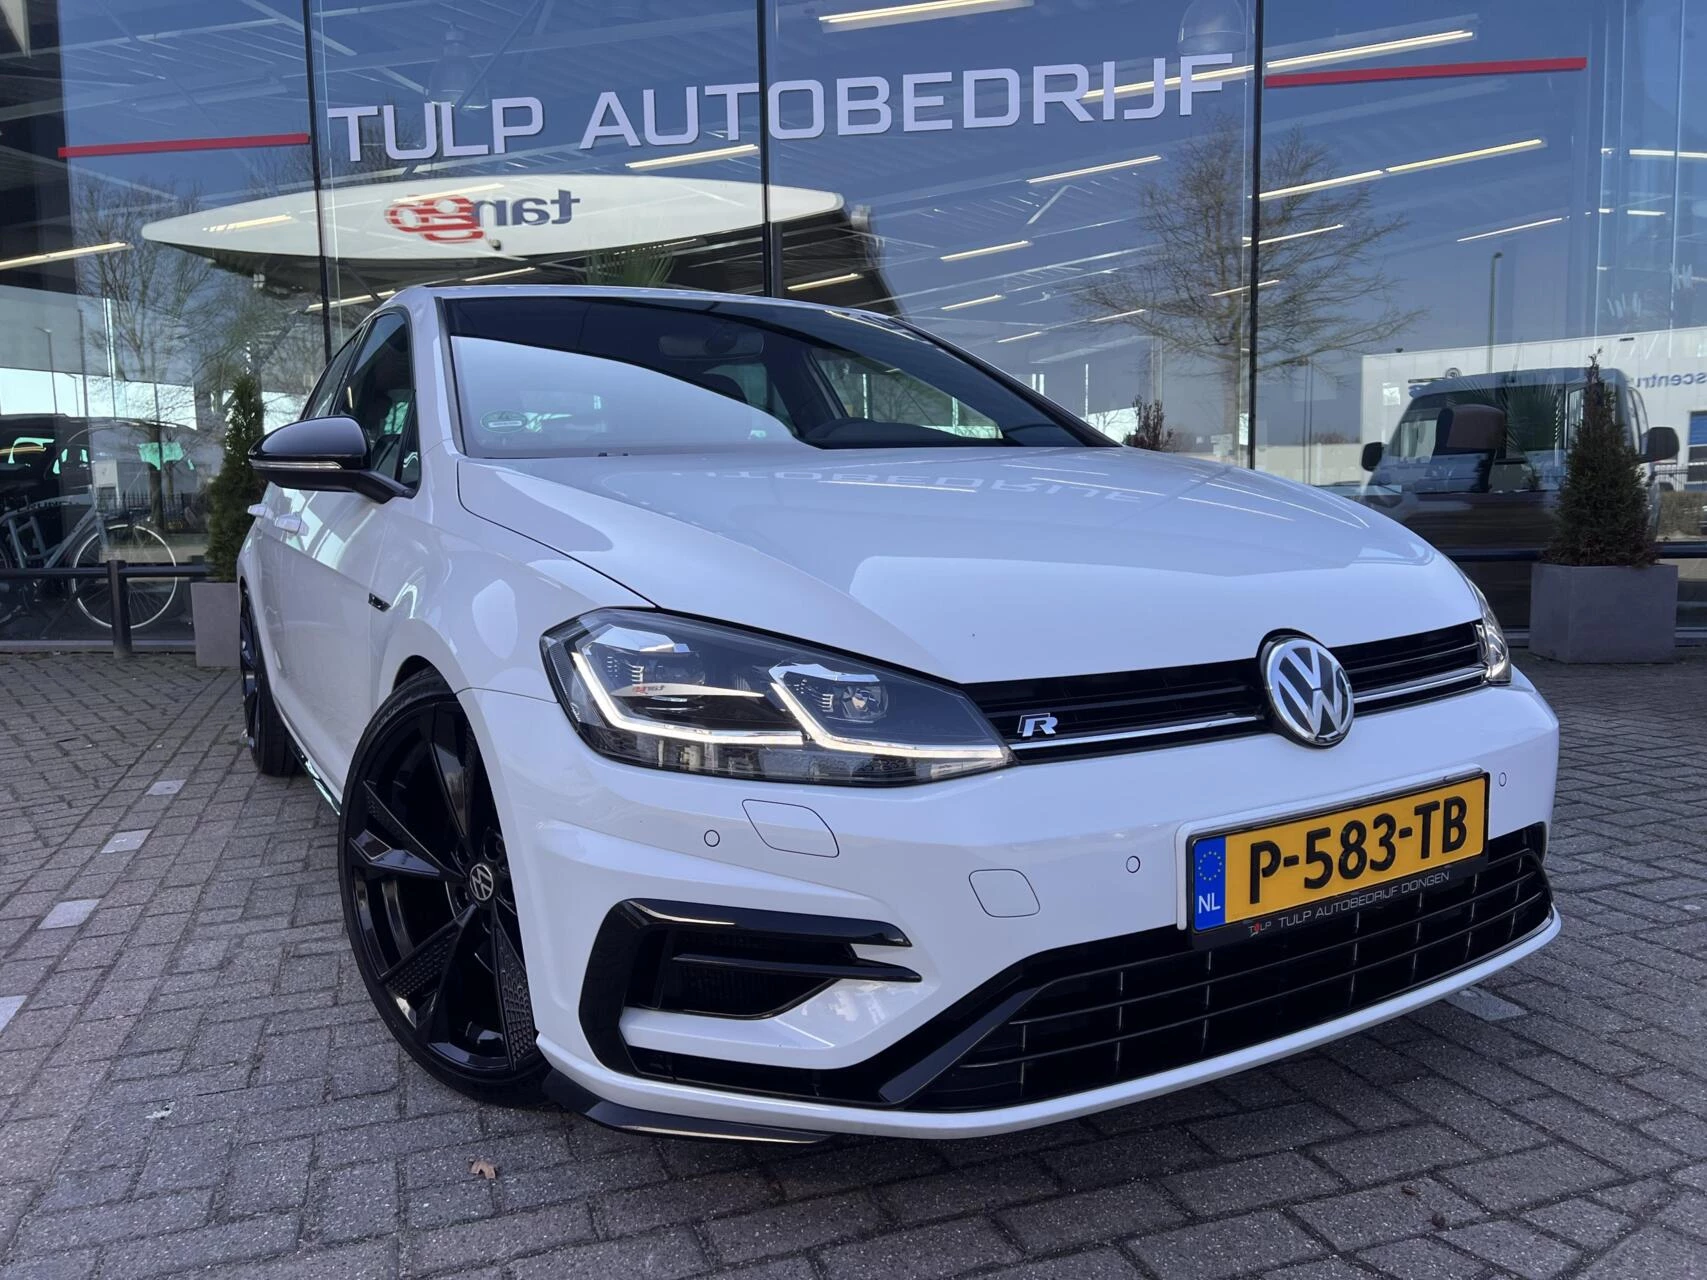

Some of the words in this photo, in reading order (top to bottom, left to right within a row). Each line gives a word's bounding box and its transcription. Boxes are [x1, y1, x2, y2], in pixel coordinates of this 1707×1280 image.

[328, 96, 544, 162] TULP
[579, 53, 1233, 149] AUTOBEDRIJF
[1021, 715, 1059, 738] R
[1249, 795, 1467, 905] P-583-TB
[1198, 892, 1221, 914] NL
[1279, 909, 1312, 930] TULP
[1315, 887, 1399, 920] AUTOBEDRIJF
[1401, 871, 1450, 894] DONGEN
